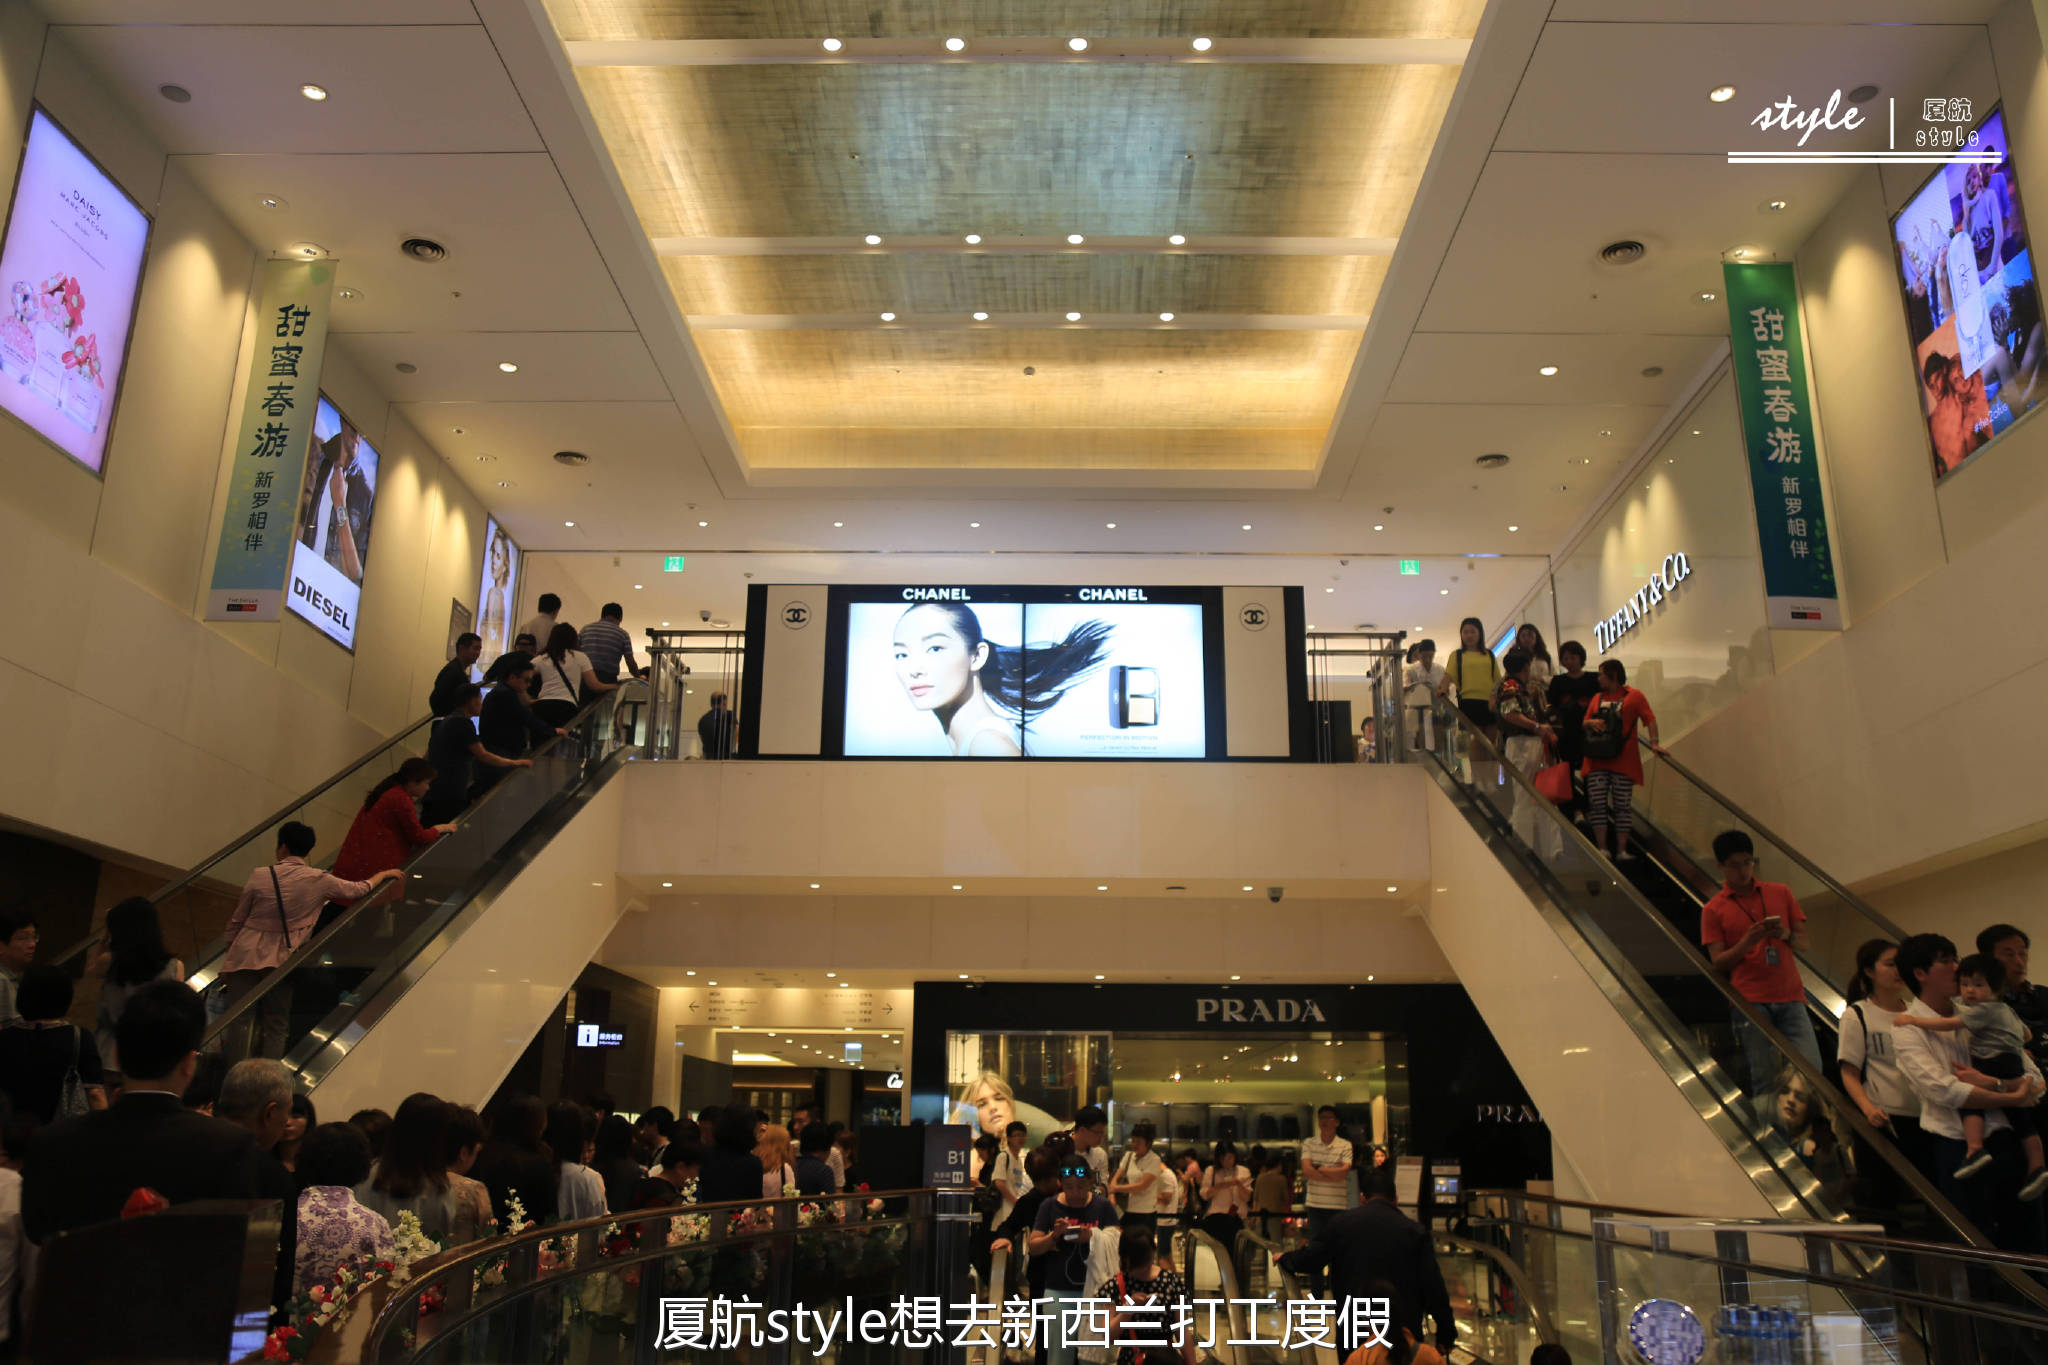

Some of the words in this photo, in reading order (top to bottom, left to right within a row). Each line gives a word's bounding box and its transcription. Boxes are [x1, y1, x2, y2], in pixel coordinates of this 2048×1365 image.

[73, 189, 101, 220] DAISY
[251, 303, 311, 458] 甜蜜春游
[1750, 306, 1803, 465] 甜蜜春游
[244, 471, 275, 551] 新罗相伴
[1782, 476, 1810, 559] 新罗相伴
[293, 576, 351, 631] DIESEL
[902, 587, 971, 601] CHANEL
[1078, 588, 1148, 601] CHANEL
[1197, 999, 1327, 1023] PRADA
[1476, 1104, 1543, 1123] PRA
[948, 1150, 965, 1165] B1
